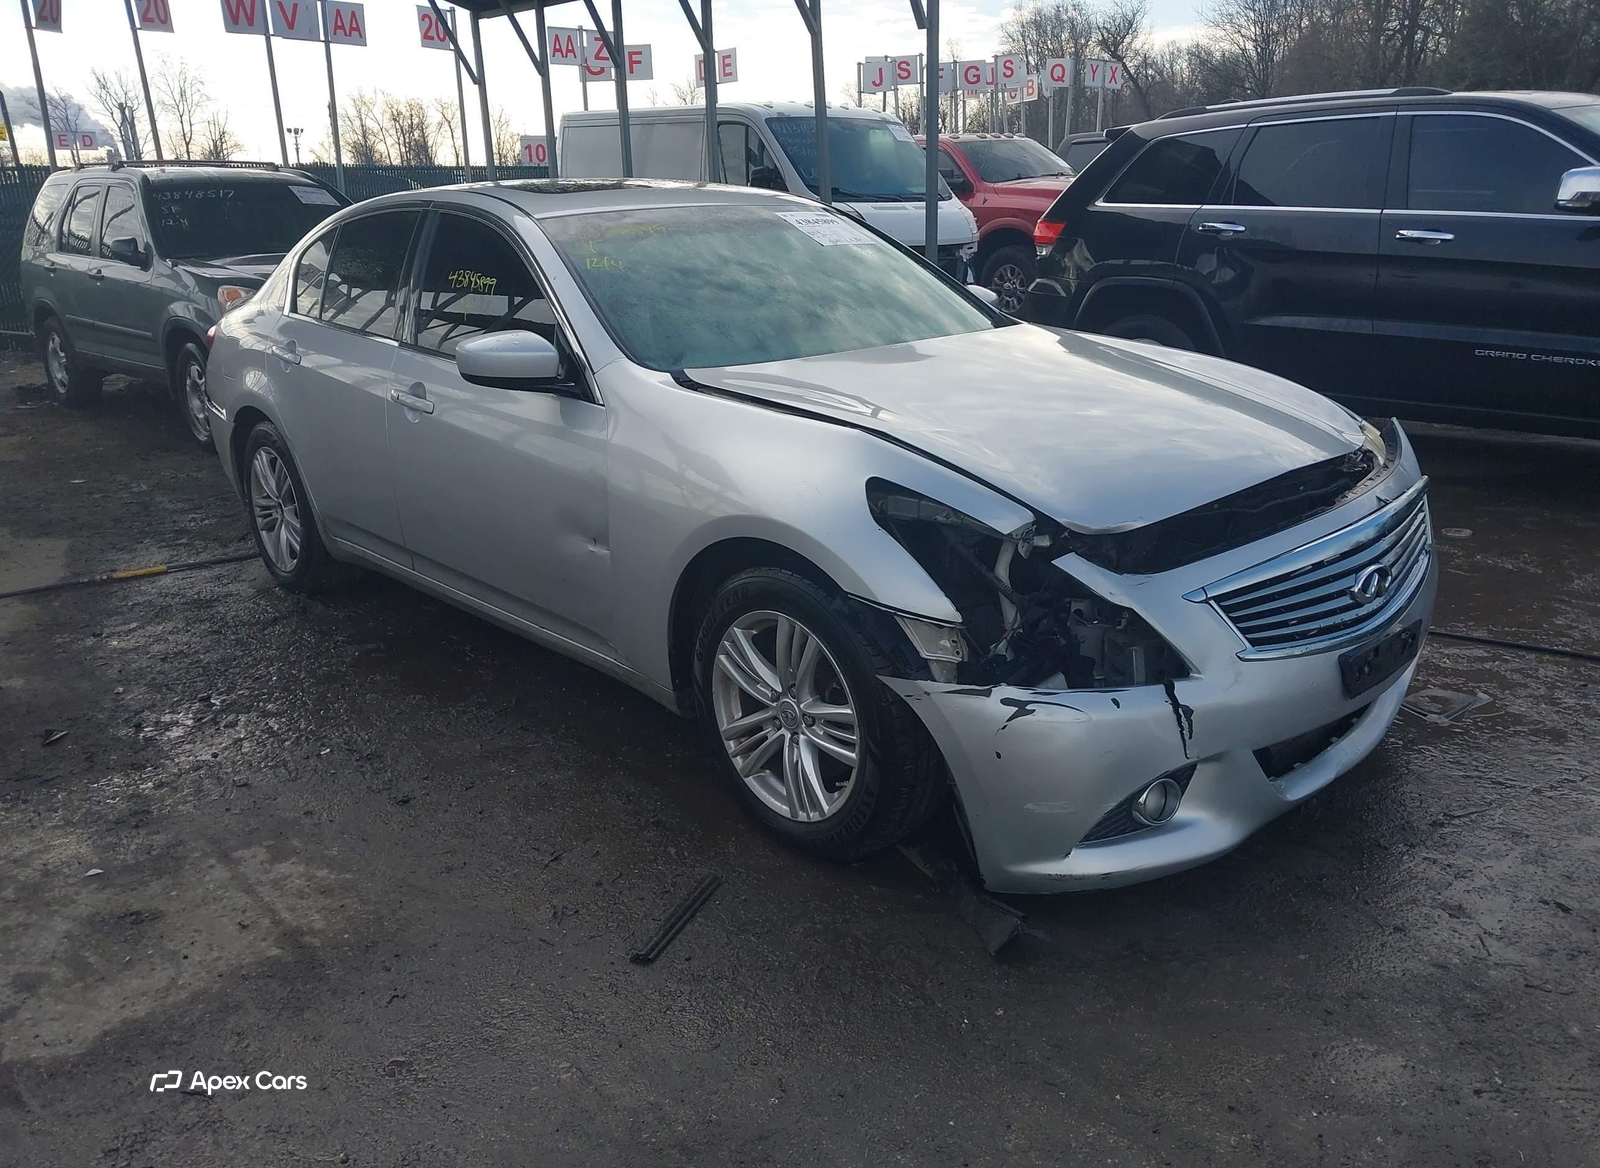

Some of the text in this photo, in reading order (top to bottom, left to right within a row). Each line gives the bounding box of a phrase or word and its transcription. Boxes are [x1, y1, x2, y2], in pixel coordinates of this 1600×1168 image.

[142, 0, 168, 25] 20
[225, 0, 256, 27] W
[277, 0, 298, 30] V
[333, 9, 363, 38] AA
[421, 14, 447, 42] 20
[552, 34, 577, 59] AA
[594, 37, 610, 61] Z
[628, 51, 642, 74] F
[722, 54, 733, 77] E
[897, 60, 911, 80] S
[1003, 59, 1014, 78] S
[1090, 63, 1099, 82] Y
[872, 67, 884, 87] J
[964, 65, 981, 85] G
[1050, 63, 1066, 83] Q
[1109, 65, 1118, 84] X
[1027, 79, 1035, 97] B
[58, 134, 69, 147] E
[82, 134, 93, 147] D
[525, 143, 547, 163] 10
[448, 269, 497, 294] 43845899
[1474, 349, 1527, 360] GRAND
